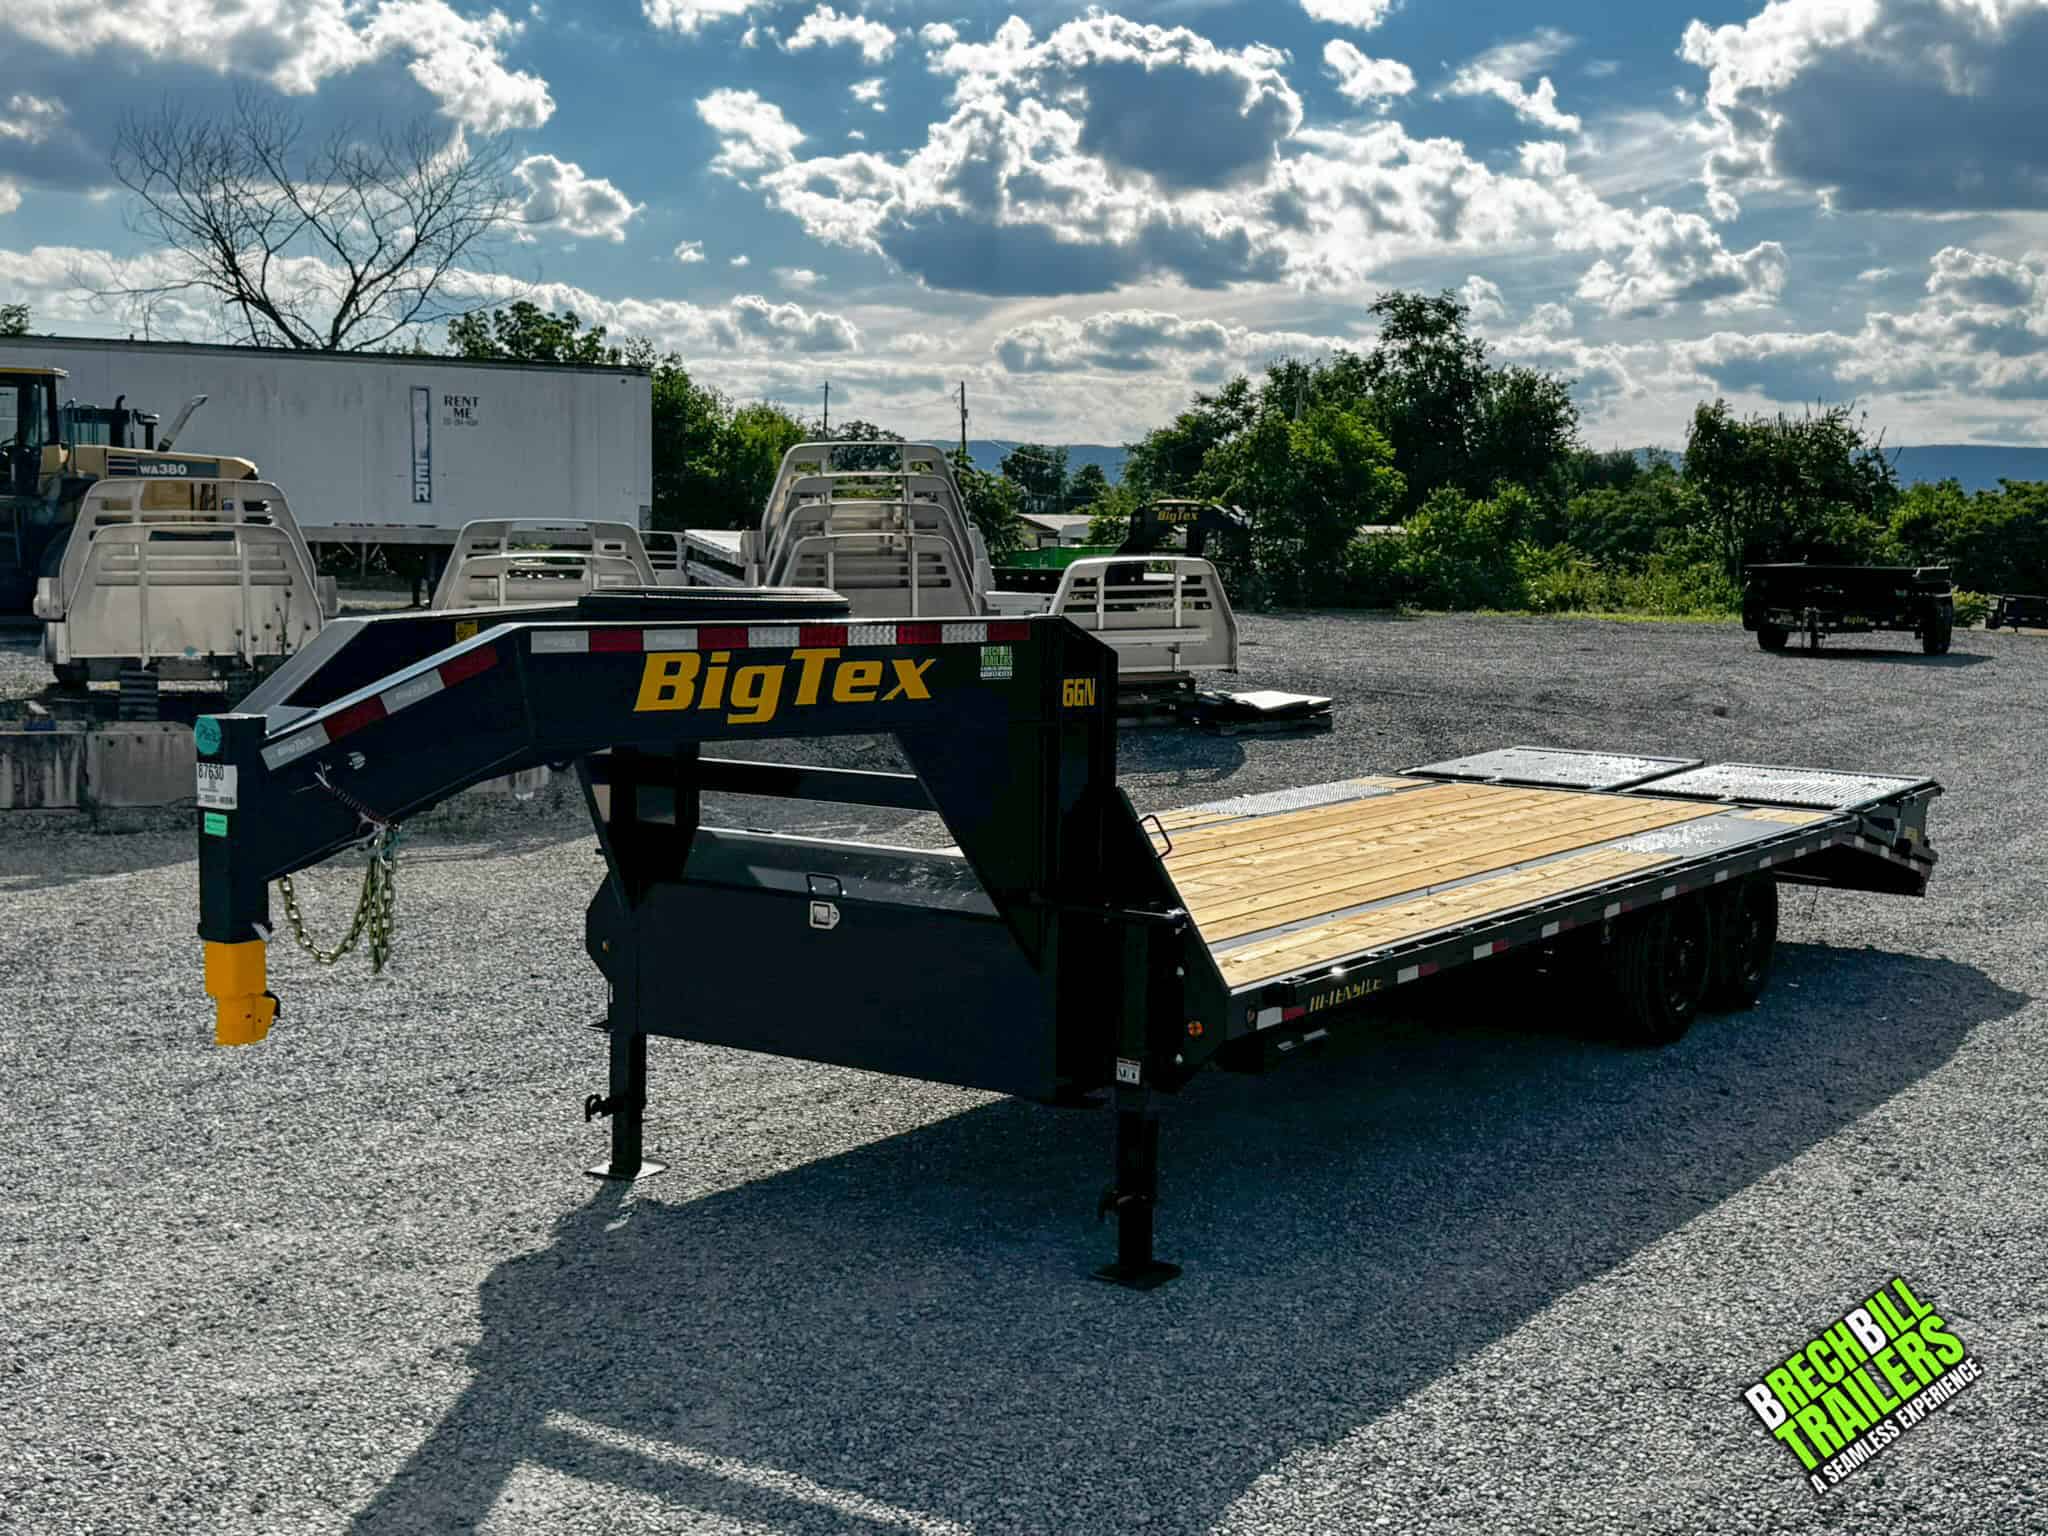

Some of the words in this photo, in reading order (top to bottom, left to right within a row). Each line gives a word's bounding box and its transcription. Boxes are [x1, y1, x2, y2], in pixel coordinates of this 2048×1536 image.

[443, 395, 480, 408] RENT
[454, 408, 472, 419] ME
[139, 463, 188, 475] WA380
[633, 648, 936, 724] BigTex
[1309, 976, 1383, 1012] HI-TENSILE
